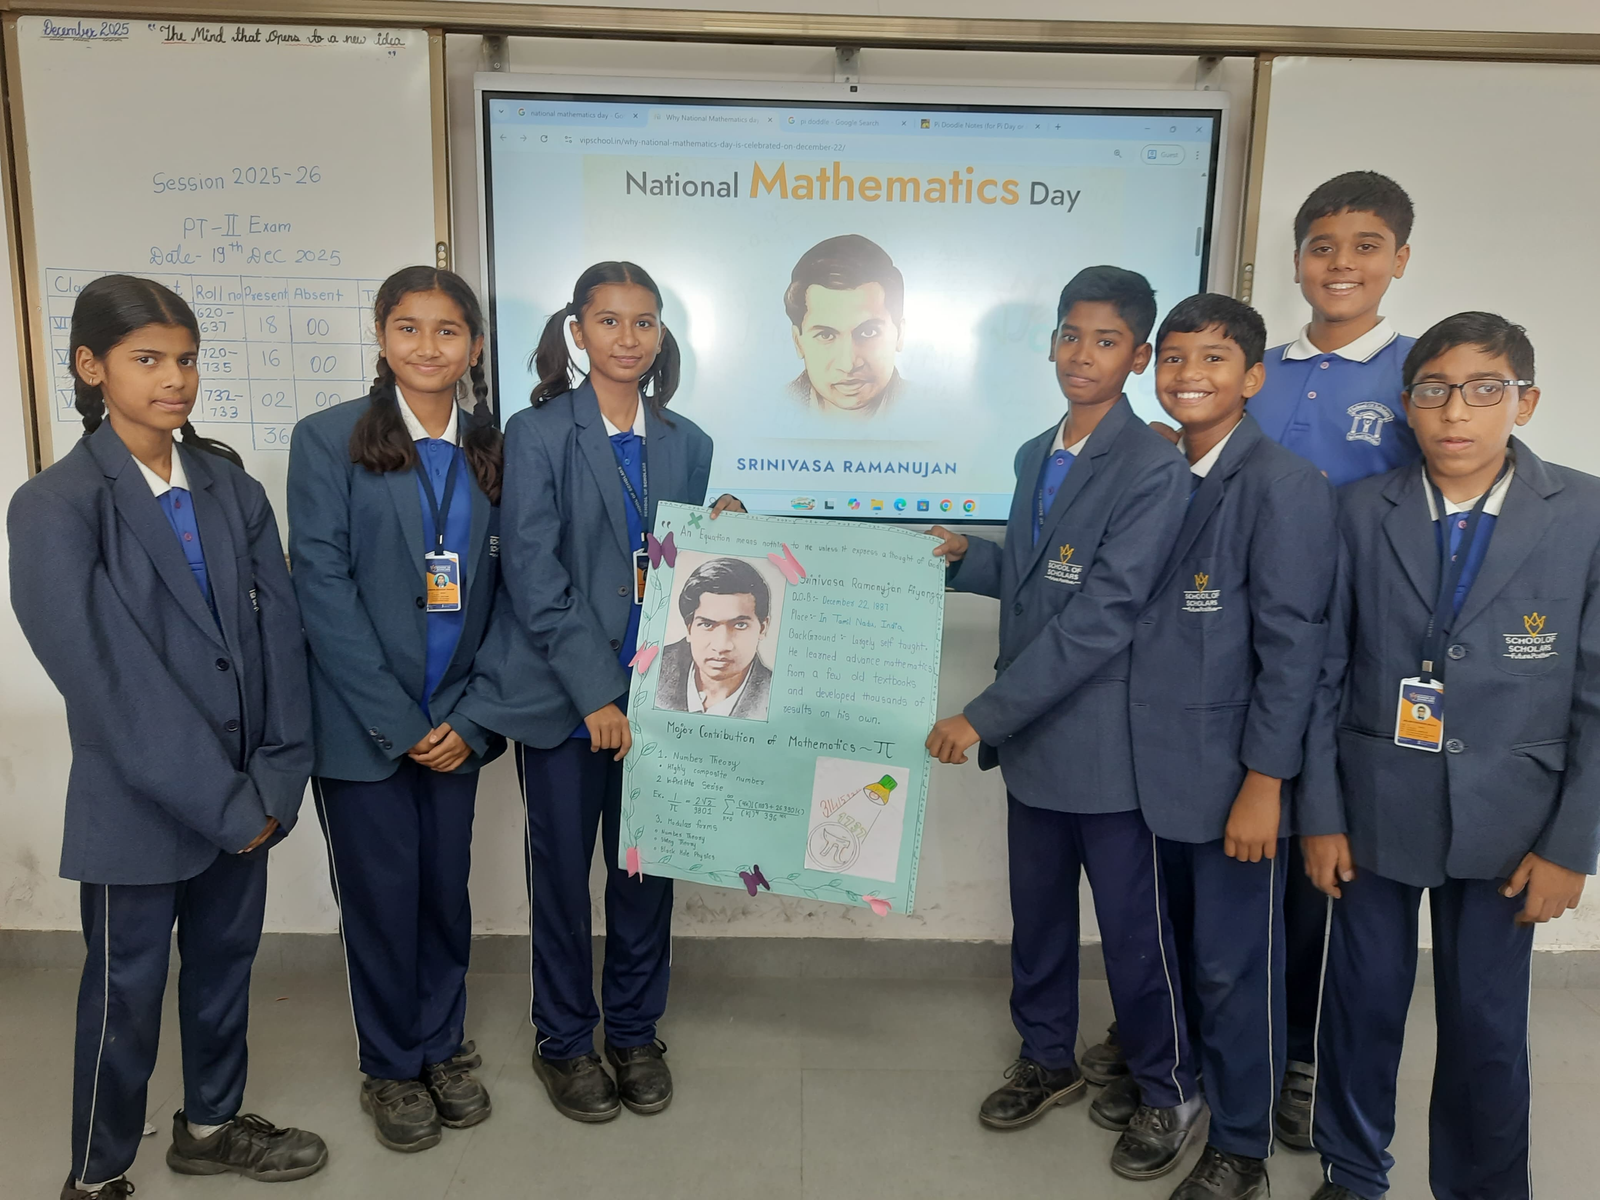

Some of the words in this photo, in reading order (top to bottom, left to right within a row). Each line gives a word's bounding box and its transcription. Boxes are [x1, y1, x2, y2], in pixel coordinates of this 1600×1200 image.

[43, 19, 97, 38] December
[100, 22, 130, 36] 2025
[160, 25, 186, 41] The
[191, 26, 226, 44] Mind
[231, 26, 262, 43] that
[306, 29, 324, 44] to
[342, 35, 366, 44] new
[374, 32, 406, 46] idea
[597, 112, 609, 120] day
[666, 114, 680, 122] Why
[681, 114, 708, 122] National
[709, 115, 748, 123] Mathematics
[836, 119, 858, 127] Google
[1004, 124, 1016, 132] Day
[153, 172, 224, 194] Session
[232, 165, 322, 185] 2025-26
[626, 170, 738, 198] National
[750, 161, 1020, 206] Mathematics
[1029, 181, 1081, 213] Day
[249, 215, 291, 234] Exam
[295, 249, 341, 266] 2025
[55, 276, 86, 293] Cla
[196, 285, 222, 300] Roll
[228, 291, 242, 301] no
[244, 285, 288, 301] Present
[294, 287, 344, 302] Absent
[197, 307, 234, 319] 620-
[200, 321, 226, 333] 637
[259, 315, 277, 334] 18
[307, 318, 329, 336] 00
[201, 347, 238, 359] 720-
[262, 349, 281, 367] 16
[202, 362, 232, 373] 735
[310, 355, 337, 373] 00
[261, 392, 292, 408] 02
[210, 406, 239, 419] 733
[264, 427, 290, 445] 36
[736, 457, 835, 473] SRINIVASA
[843, 460, 957, 478] RAMANUJAN
[680, 525, 692, 538] An
[699, 528, 731, 545] Equation
[790, 541, 800, 550] to
[1505, 636, 1545, 644] SCHOOL
[788, 646, 798, 657] He
[805, 646, 837, 662] learned
[845, 653, 881, 667] advance
[787, 664, 806, 678] from
[812, 670, 819, 679] a
[826, 667, 842, 681] few
[851, 671, 866, 682] old
[872, 671, 918, 689] textbooks
[787, 686, 804, 697] and
[815, 686, 857, 703] developed
[861, 691, 908, 707] thousands
[914, 696, 926, 708] of
[819, 709, 831, 719] on
[836, 708, 851, 721] his
[666, 721, 695, 740] Major
[699, 724, 756, 745] Contribution
[767, 734, 778, 746] of
[788, 735, 857, 753] Mathematics
[672, 752, 704, 764] Number
[695, 819, 718, 832] forms
